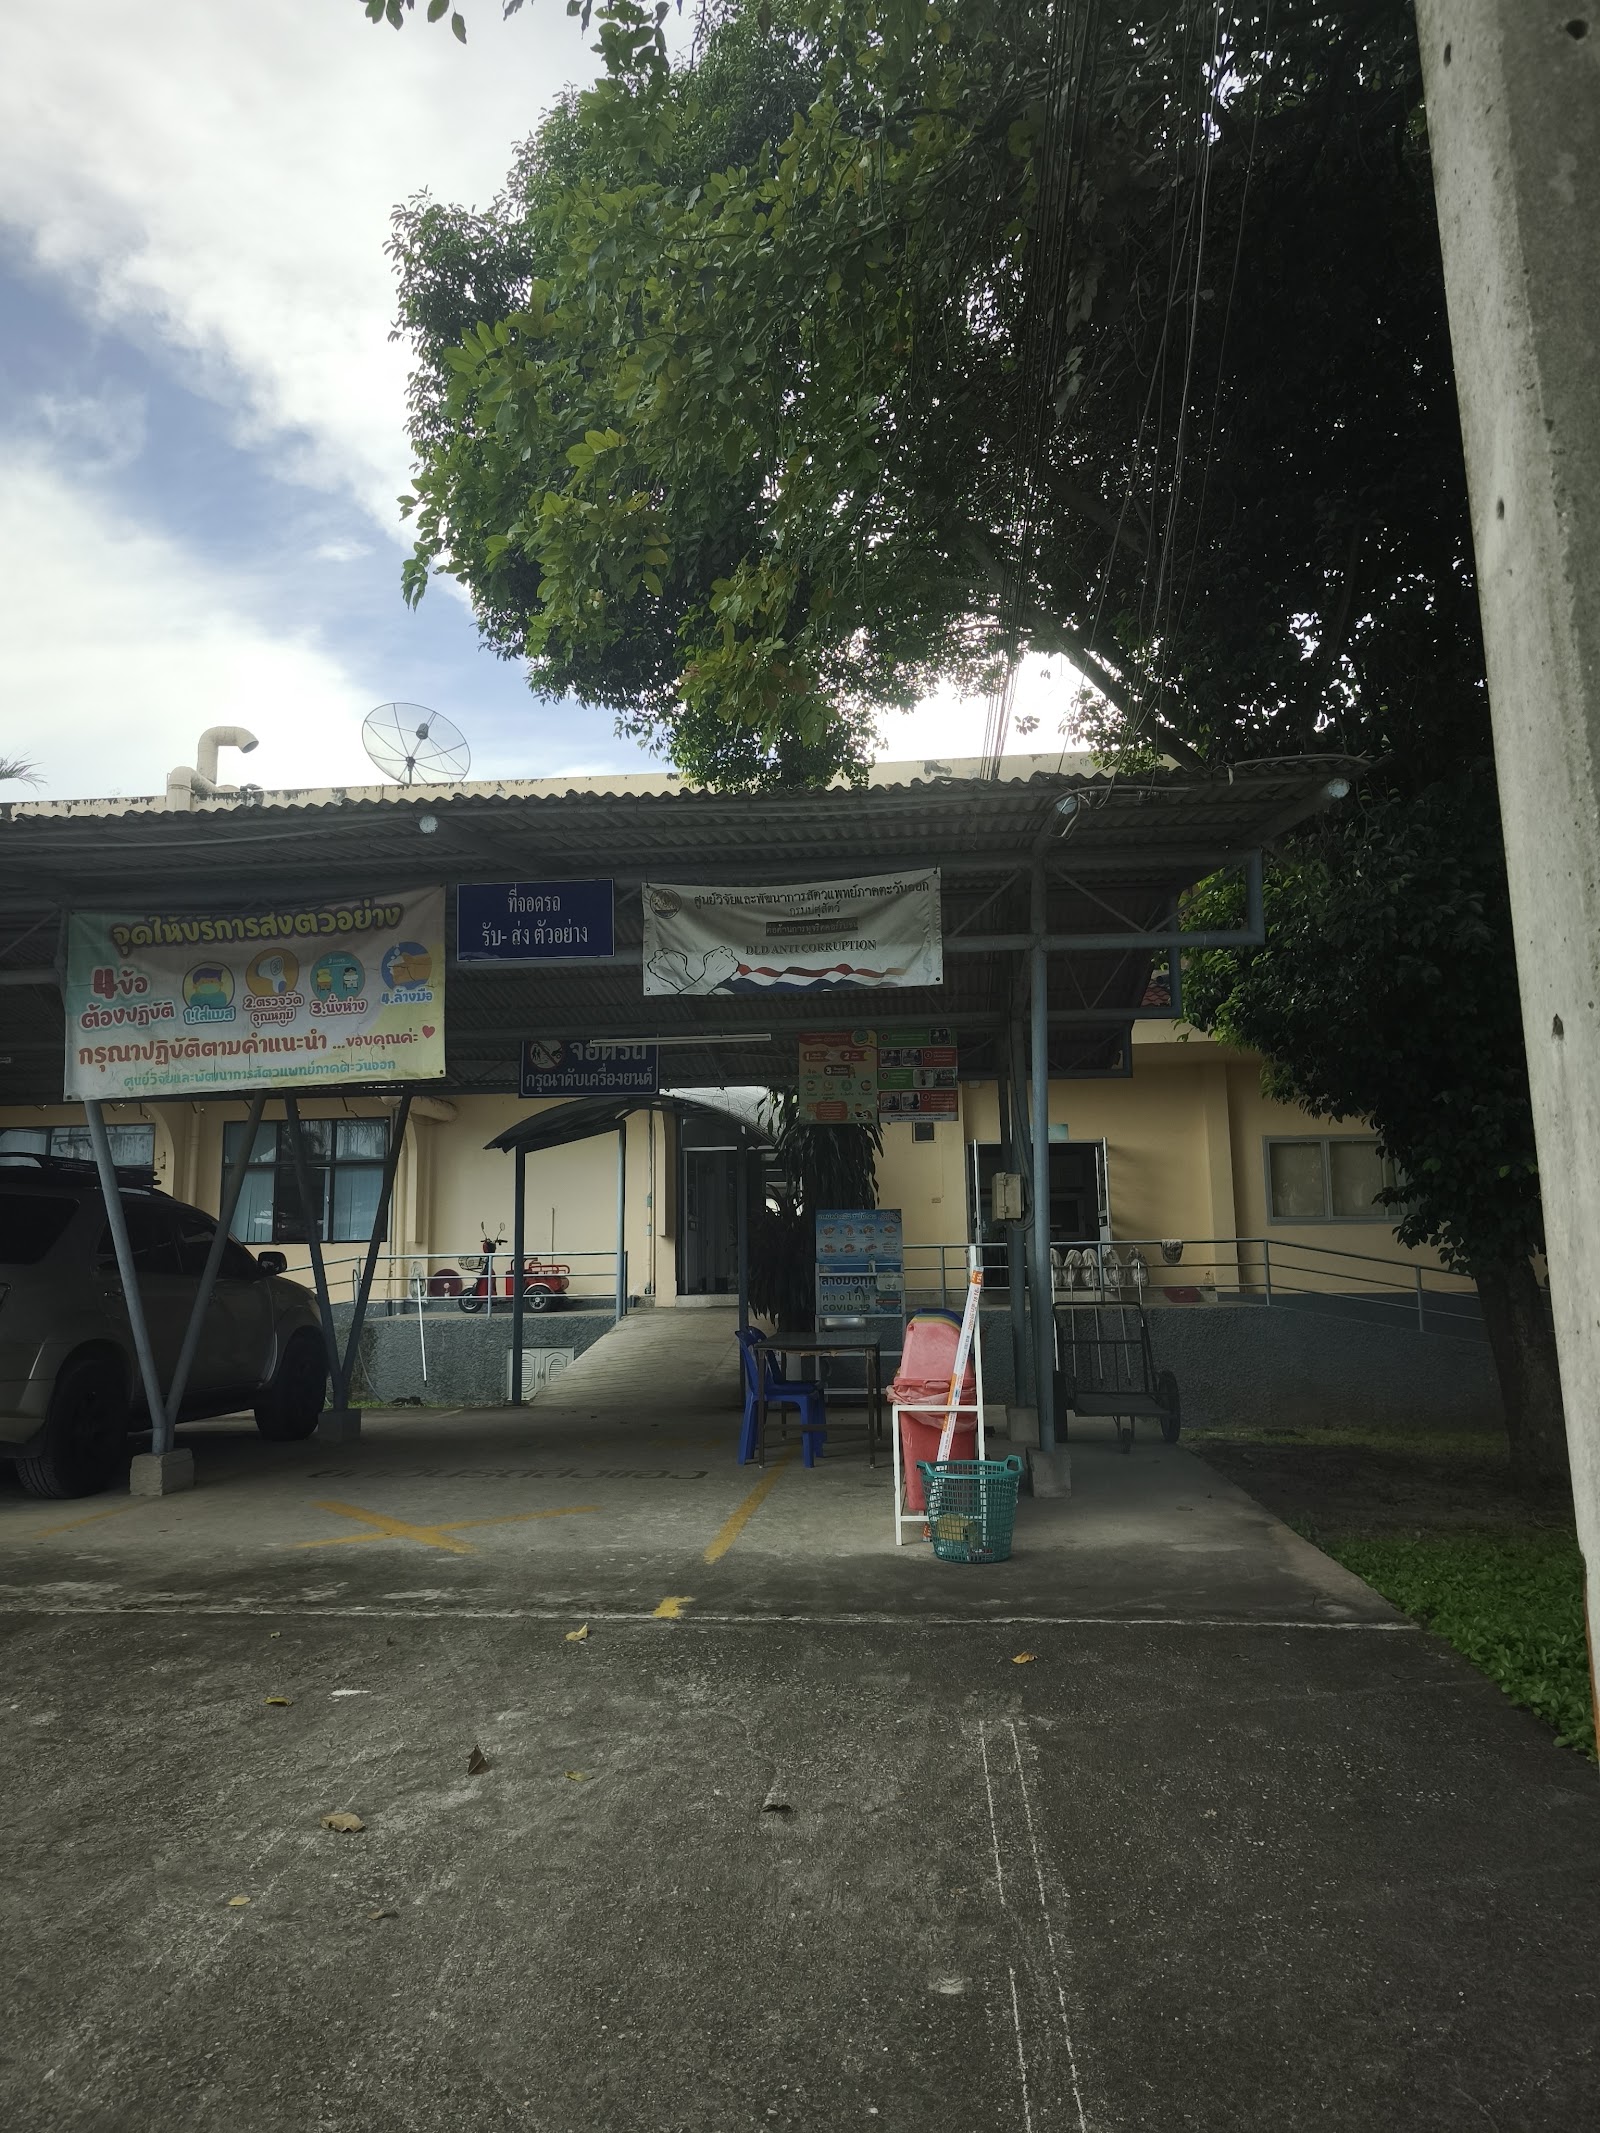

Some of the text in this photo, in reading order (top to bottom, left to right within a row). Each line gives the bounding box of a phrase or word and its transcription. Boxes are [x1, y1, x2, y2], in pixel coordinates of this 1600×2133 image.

[508, 884, 561, 912] ที่จอดรถ
[789, 901, 841, 917] กรมปศุสัตว์
[511, 921, 530, 945] ส่ง
[534, 919, 588, 944] ตัวอย่าง
[746, 939, 876, 955] DLD ANTI CORRUPTION
[245, 992, 302, 1009] 2.ตรวจวัด
[311, 994, 365, 1014] 3.นั่งห่าง
[381, 988, 433, 1004] 4.ล้างมือ
[81, 1001, 174, 1028] ต้องปฏิบัติ
[185, 1005, 233, 1023] 1.ใส่แมส
[253, 1009, 294, 1026] อุณหภูมิ
[79, 1029, 327, 1072] กรุณาปฏิบัติตามคำแนะนำ
[569, 1042, 647, 1061] จอดรถ
[124, 1060, 396, 1091] ศูนย์วิจัยและพัฒนาการสัตวแพทย์ภาคตะวันออก
[526, 1063, 654, 1092] กรุณาดับเครื่องยนต์
